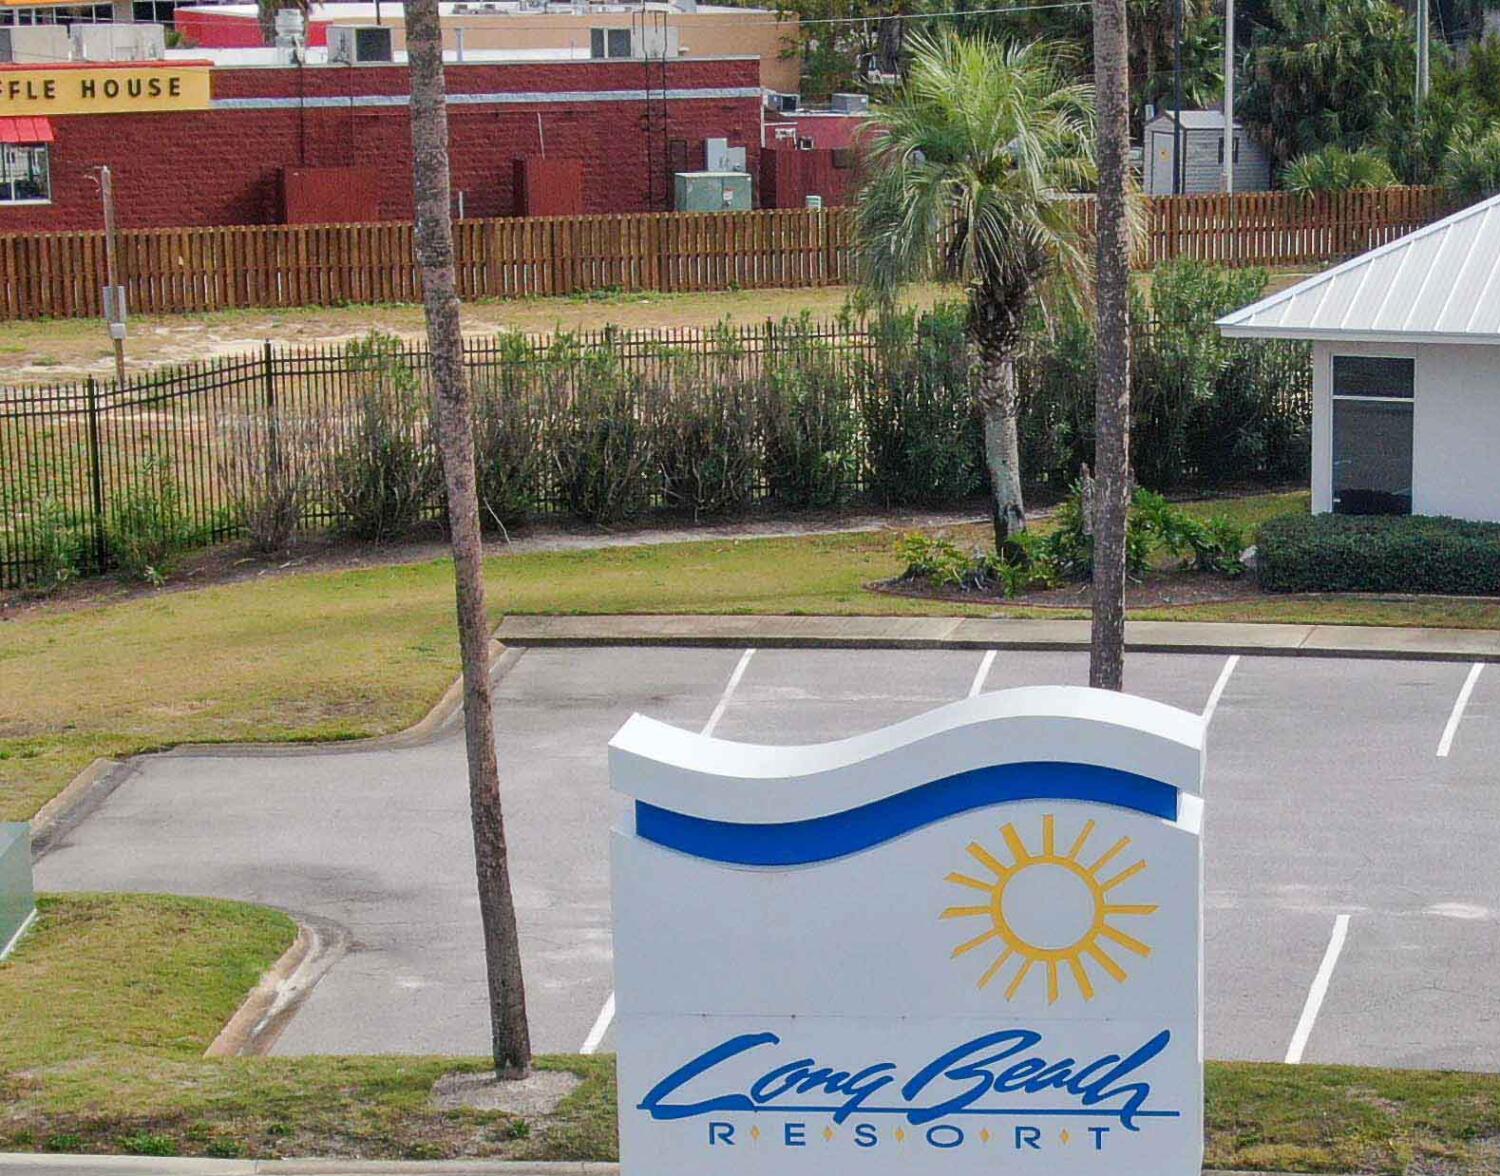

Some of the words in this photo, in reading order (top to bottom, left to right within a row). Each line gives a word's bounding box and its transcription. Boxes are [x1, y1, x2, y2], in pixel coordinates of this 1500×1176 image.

[0, 80, 56, 100] FLE
[81, 77, 181, 98] HOUSE
[636, 1032, 897, 1124] Long
[901, 1029, 1171, 1132] Beach
